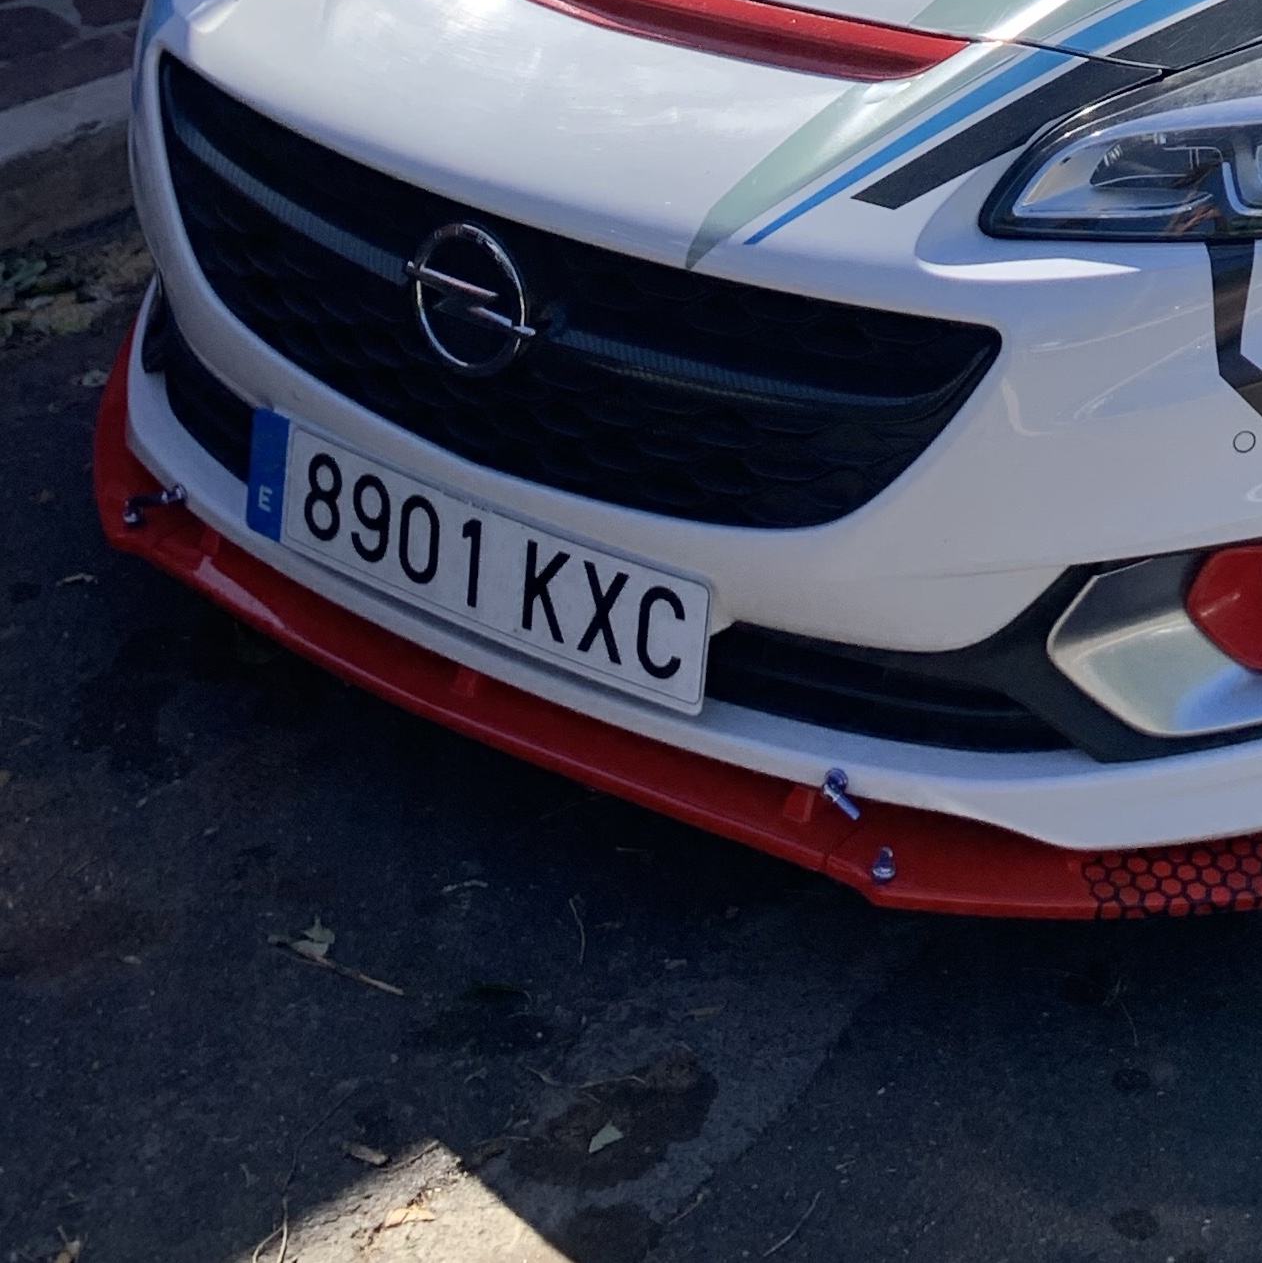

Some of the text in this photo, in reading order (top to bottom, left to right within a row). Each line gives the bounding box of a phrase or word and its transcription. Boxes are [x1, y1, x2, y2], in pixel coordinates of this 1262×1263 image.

[257, 486, 273, 513] E
[303, 452, 687, 680] 8901 KXC
